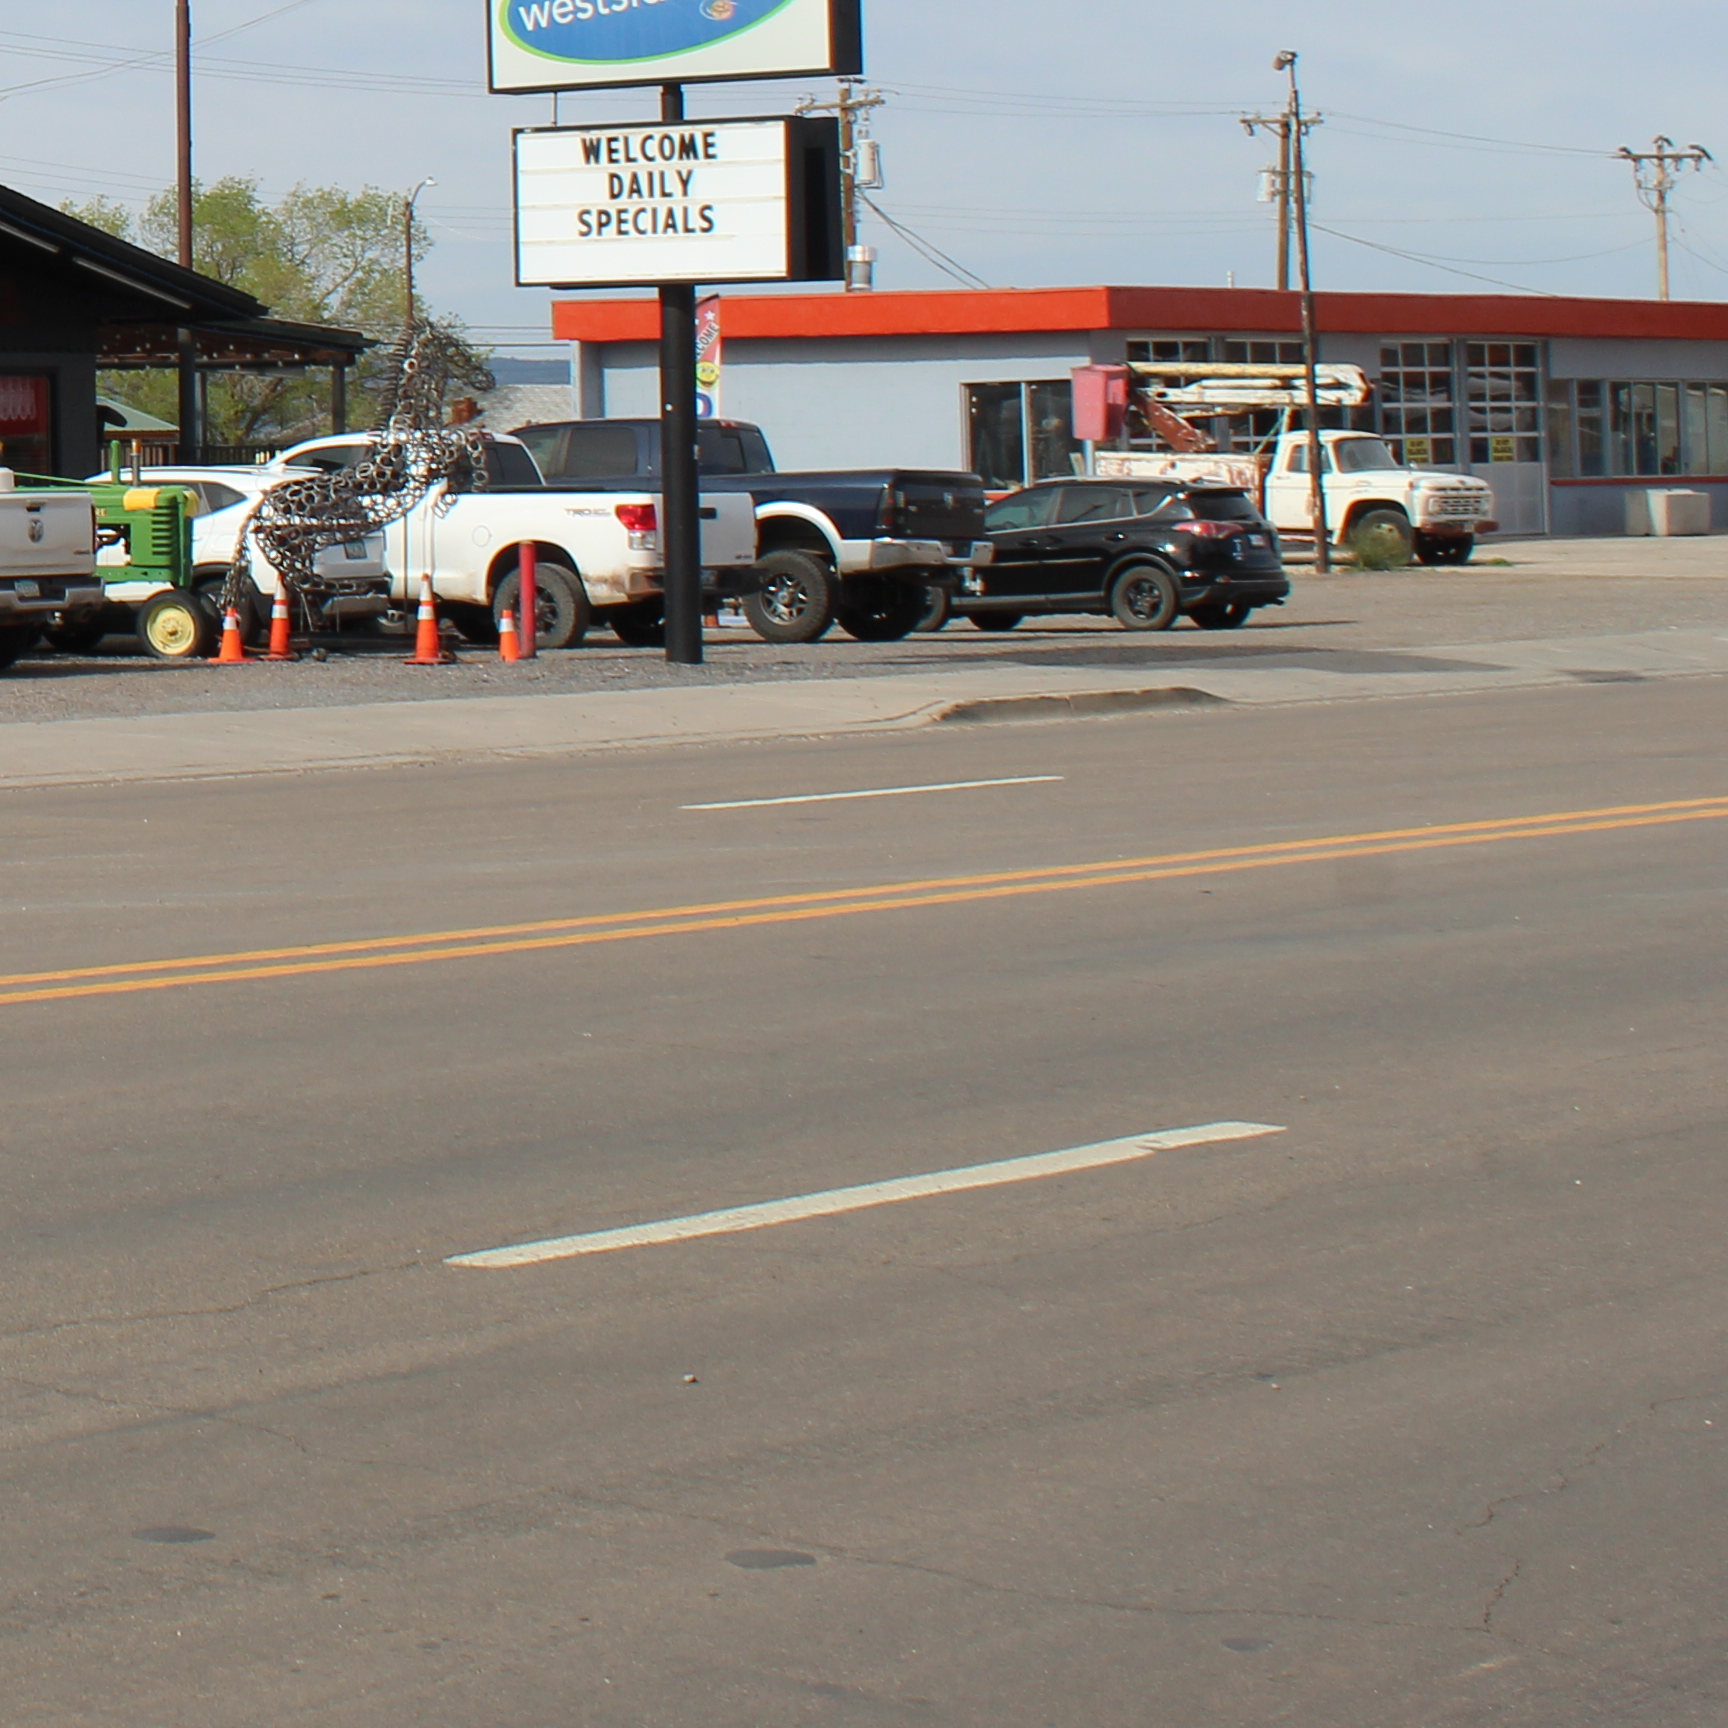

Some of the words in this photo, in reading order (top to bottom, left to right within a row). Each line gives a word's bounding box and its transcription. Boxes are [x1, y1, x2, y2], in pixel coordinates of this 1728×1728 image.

[580, 131, 718, 165] WELCOME
[607, 168, 694, 201] DAILY
[577, 203, 715, 237] SPECIALS
